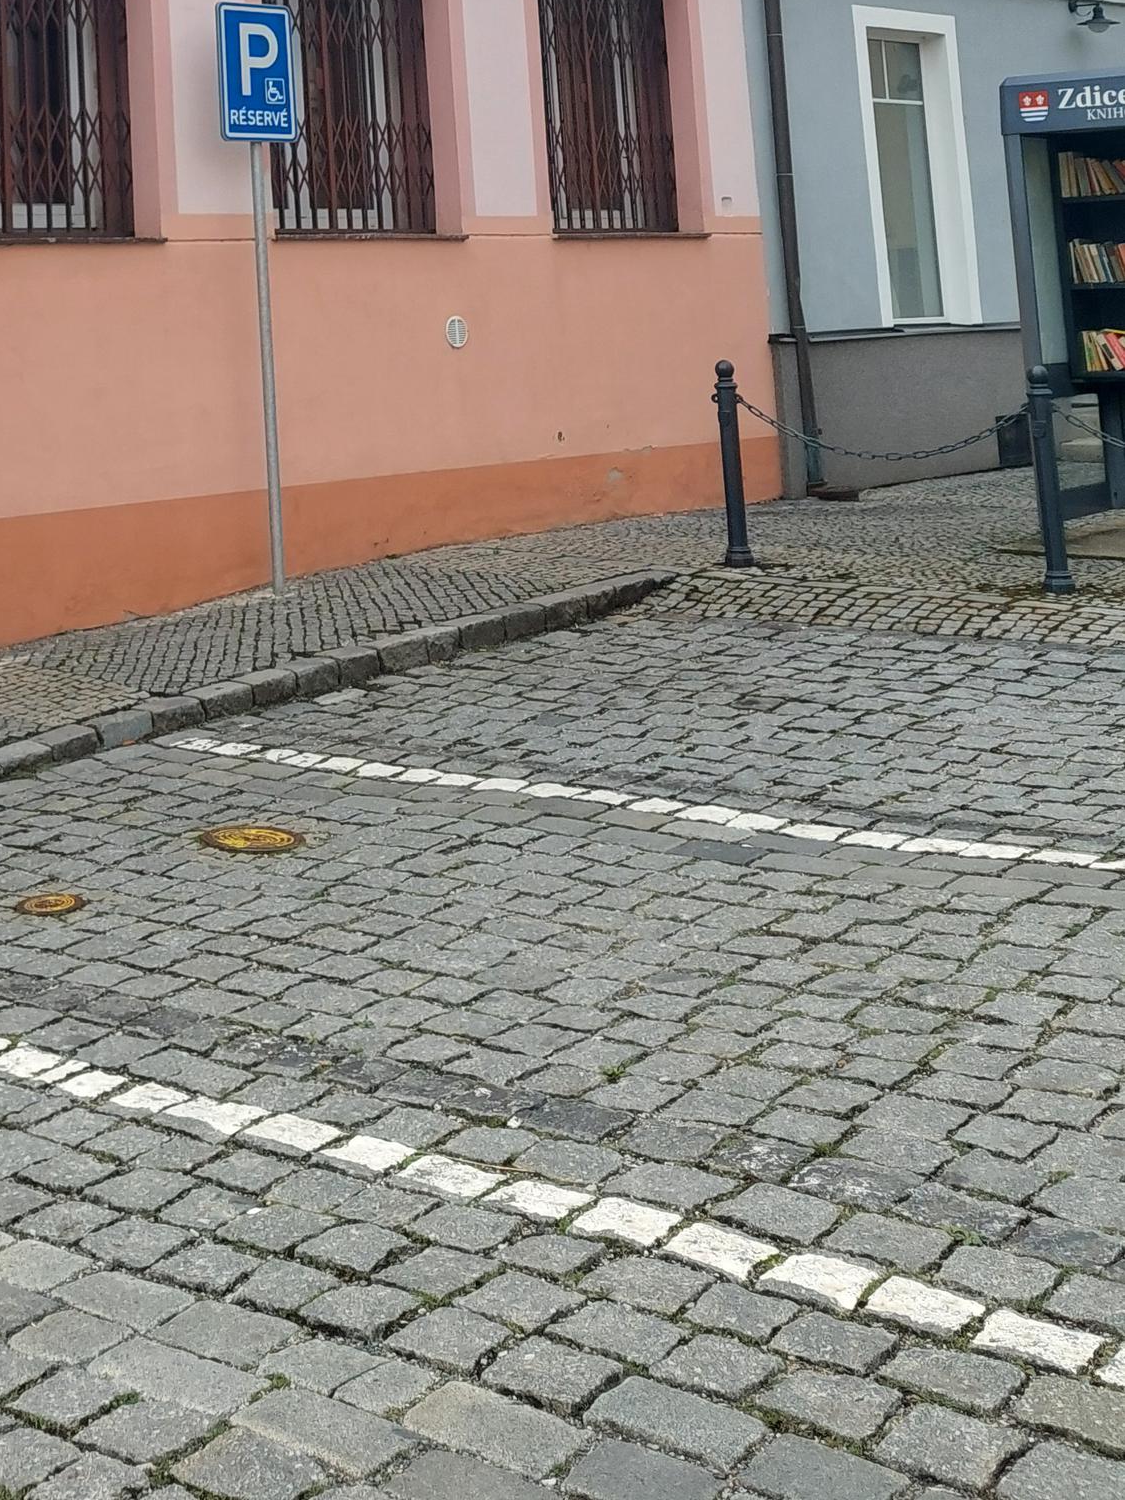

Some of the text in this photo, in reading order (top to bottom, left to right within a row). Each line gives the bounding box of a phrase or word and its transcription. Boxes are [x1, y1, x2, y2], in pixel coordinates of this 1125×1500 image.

[238, 22, 279, 96] P
[230, 106, 289, 128] RÉSERVÉ
[1086, 107, 1125, 120] KNIH
